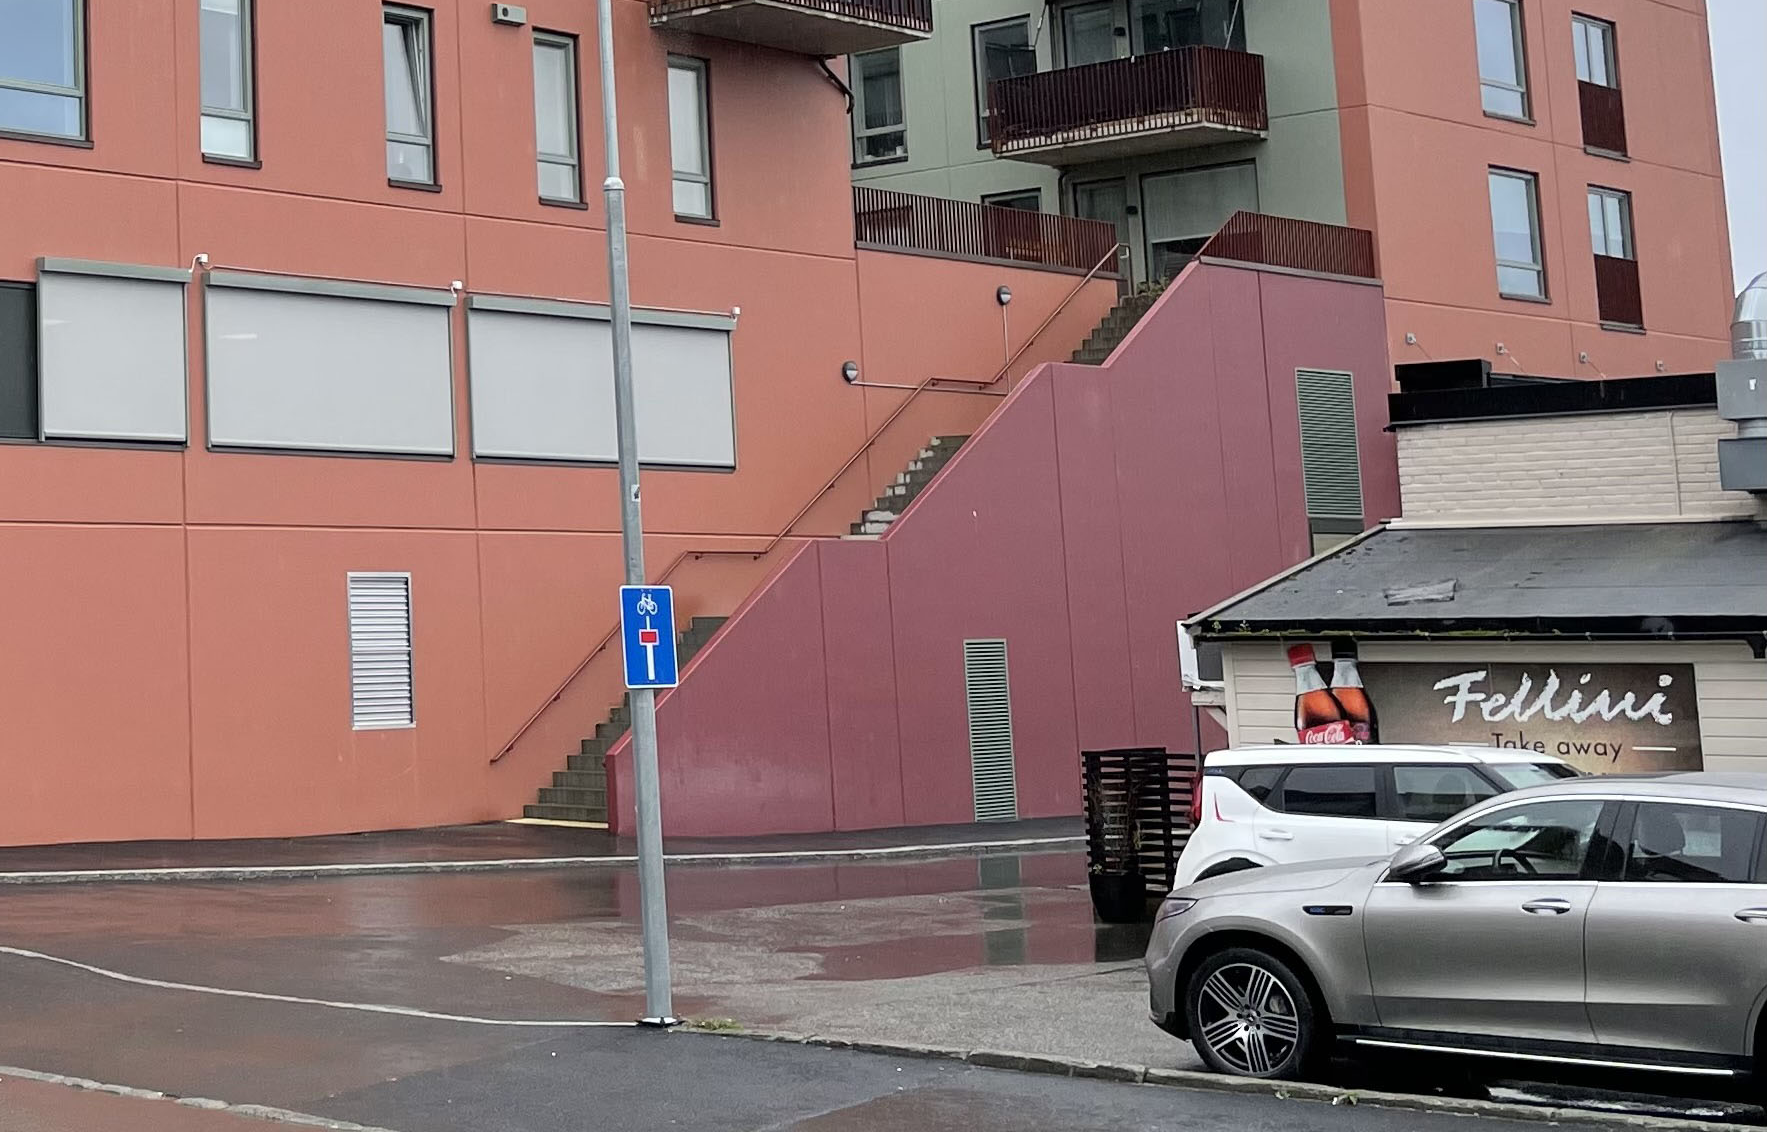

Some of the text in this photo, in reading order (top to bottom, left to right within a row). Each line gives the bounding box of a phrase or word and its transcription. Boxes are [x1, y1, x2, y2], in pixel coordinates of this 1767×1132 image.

[1433, 669, 1674, 726] Fellini
[1491, 731, 1624, 763] Take away
